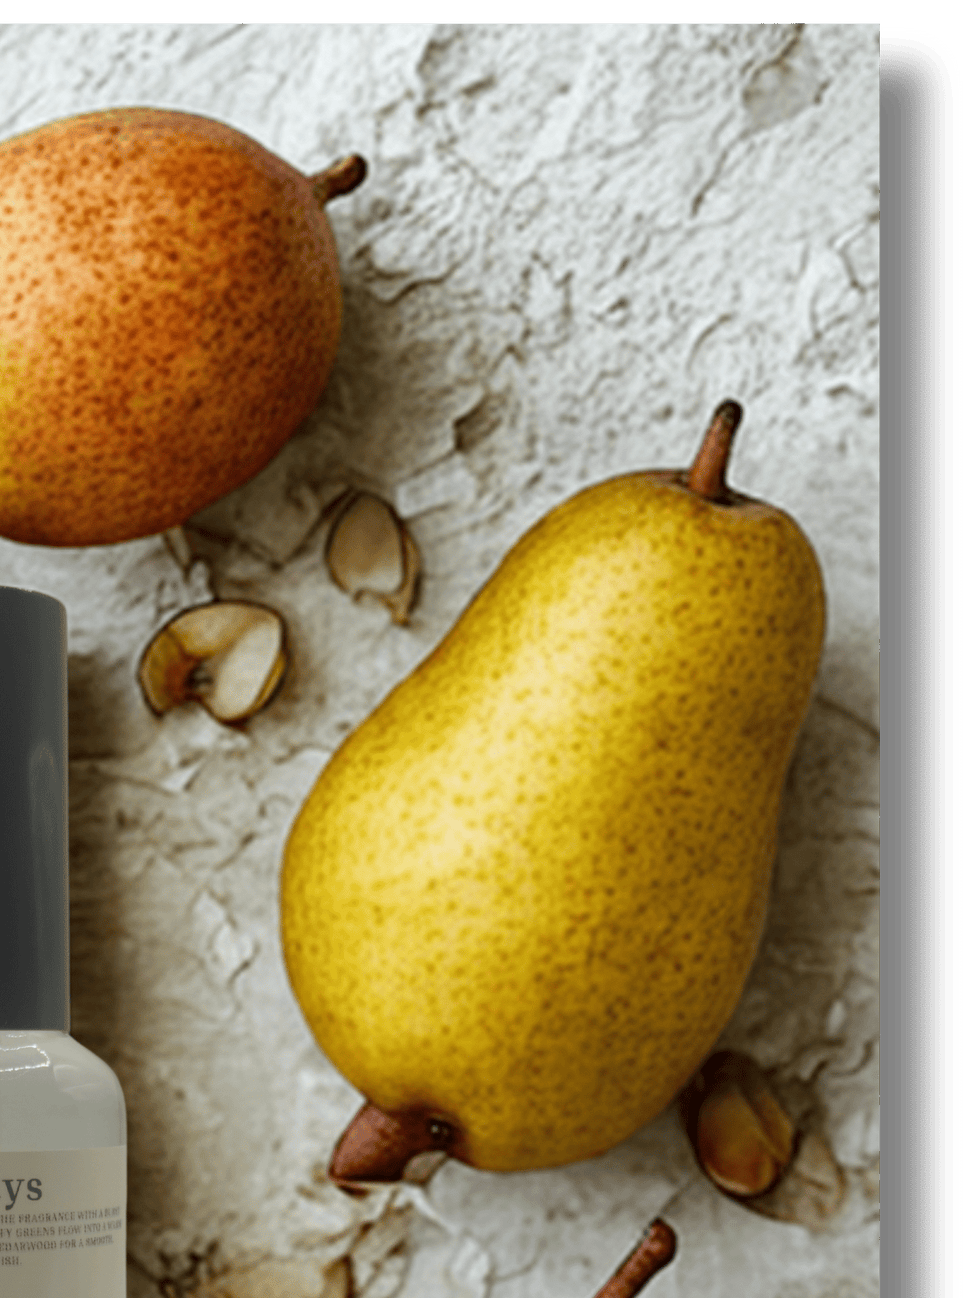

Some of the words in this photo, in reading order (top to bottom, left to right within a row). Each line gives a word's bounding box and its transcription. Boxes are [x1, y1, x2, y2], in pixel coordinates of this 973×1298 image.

[18, 1211, 76, 1224] FRAGRANCE
[77, 1209, 98, 1220] WITH
[15, 1226, 56, 1238] GREENS
[58, 1224, 82, 1236] FLOW
[83, 1222, 101, 1233] INTO
[59, 1238, 77, 1250] FOR
[78, 1238, 85, 1248] A
